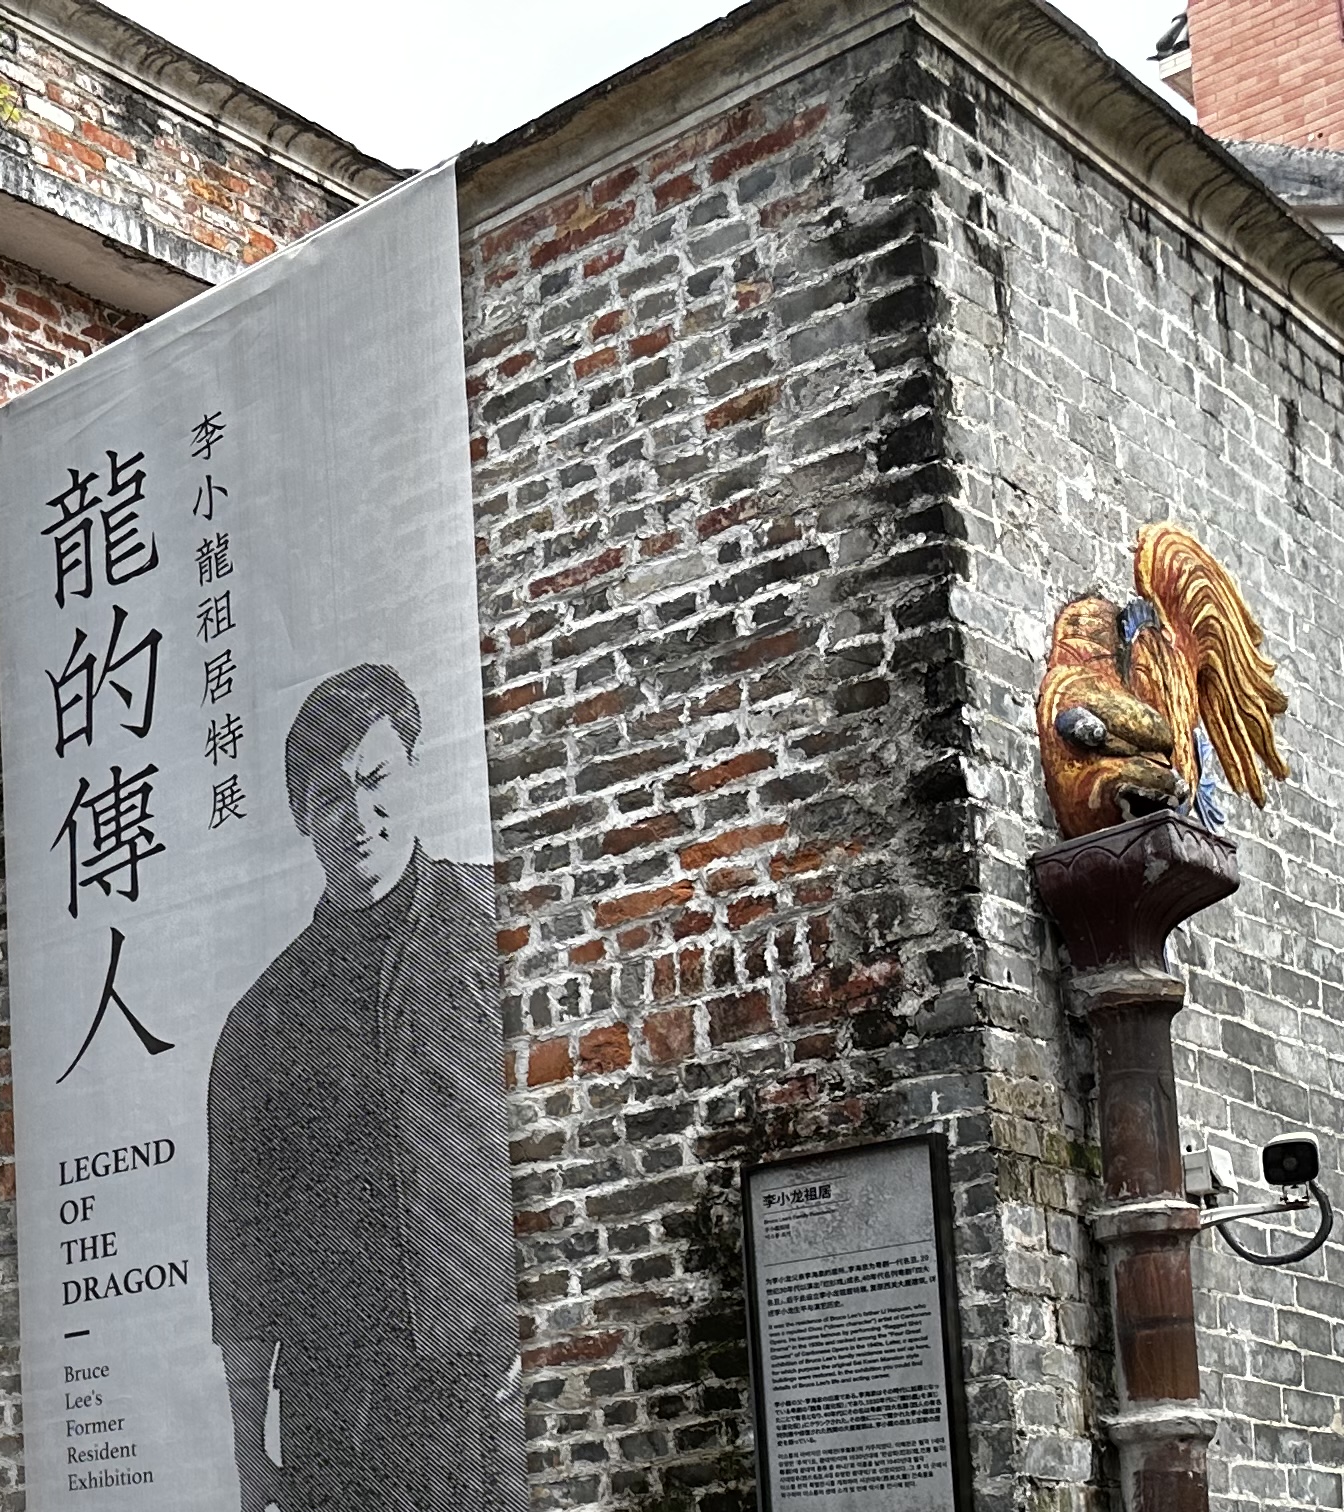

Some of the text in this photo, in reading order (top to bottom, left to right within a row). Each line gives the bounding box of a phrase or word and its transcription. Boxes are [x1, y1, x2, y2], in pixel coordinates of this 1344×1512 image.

[188, 410, 247, 829] 李小龍祖居特展
[40, 448, 175, 1084] 龍的傳人
[59, 1138, 176, 1187] LEGEND
[59, 1195, 96, 1225] OF
[763, 1184, 832, 1209] 李小龙祖居
[60, 1232, 118, 1265] THE
[62, 1260, 190, 1306] DRAGON
[64, 1363, 110, 1383] Bruce
[65, 1388, 103, 1410] Lee's
[66, 1415, 125, 1438] Former
[67, 1442, 137, 1464] Resident
[68, 1468, 154, 1492] Exhibition
